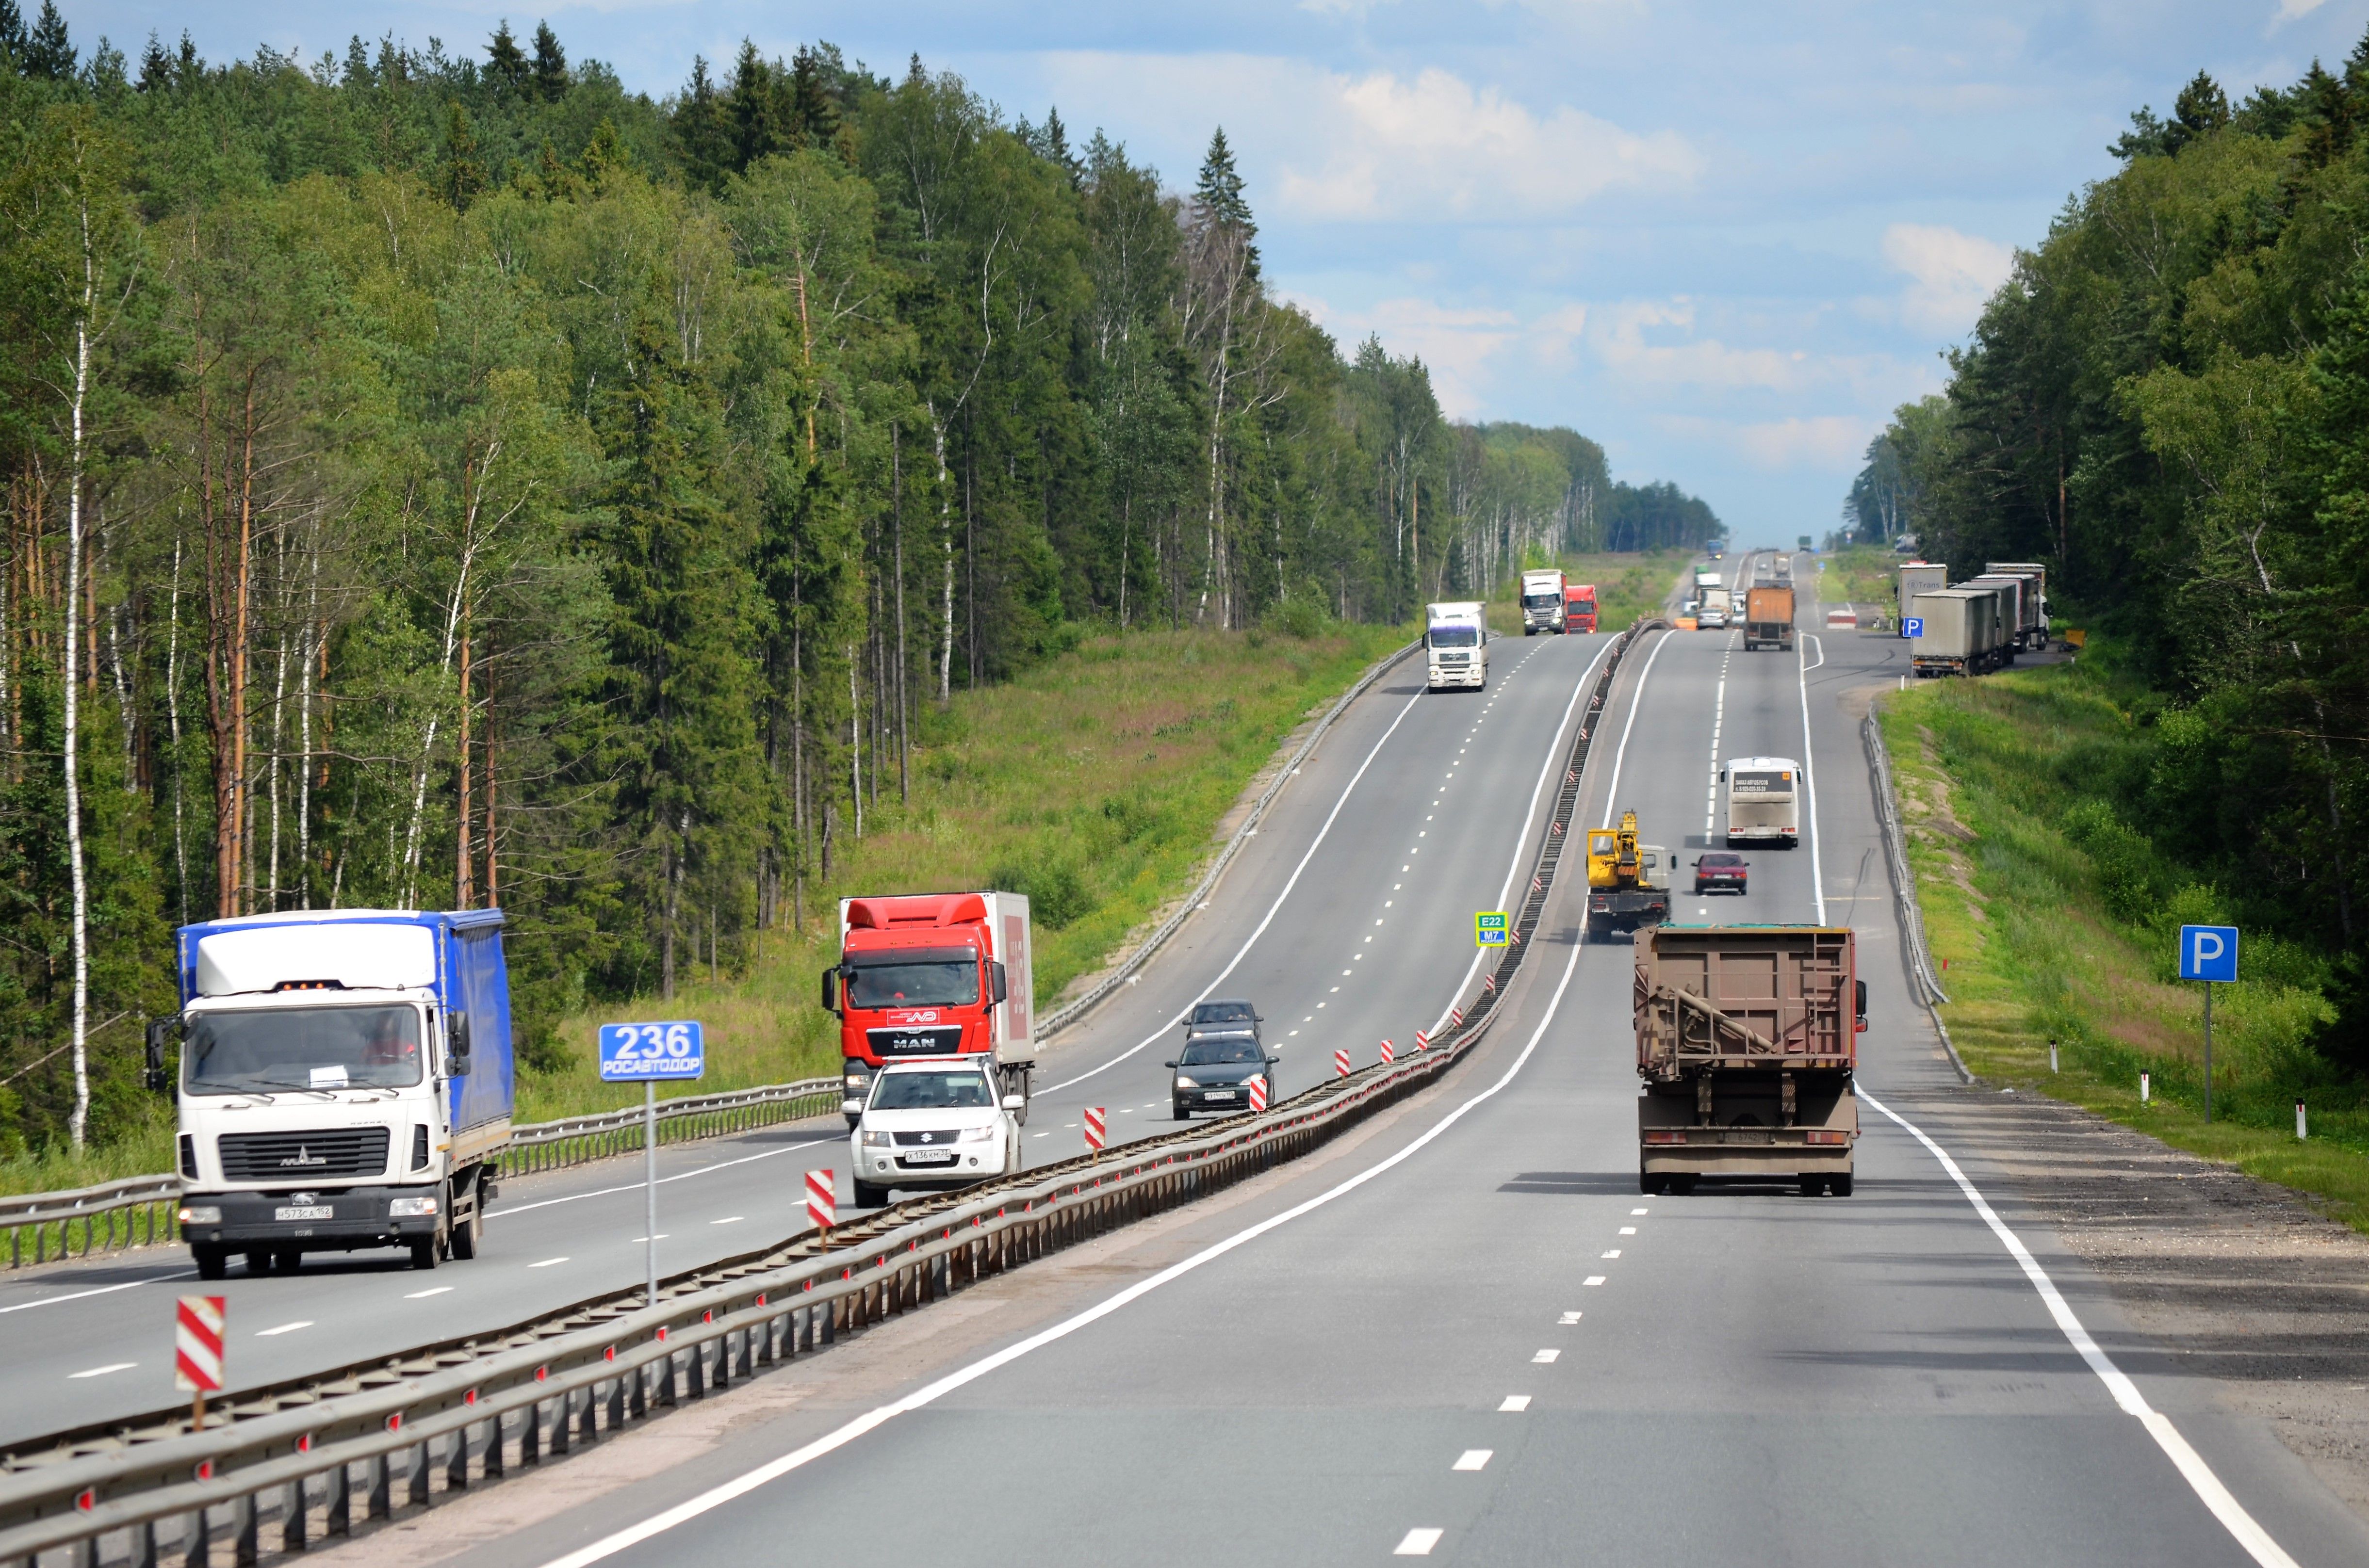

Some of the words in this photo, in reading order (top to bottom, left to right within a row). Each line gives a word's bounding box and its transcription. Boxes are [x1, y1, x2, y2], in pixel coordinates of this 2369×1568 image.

[1908, 619, 1919, 635] P
[1482, 917, 1501, 926] E22
[2193, 932, 2224, 974] P
[615, 1024, 690, 1059] 236
[893, 1038, 935, 1049] MAN
[603, 1058, 700, 1074] РОСАВТОДОР
